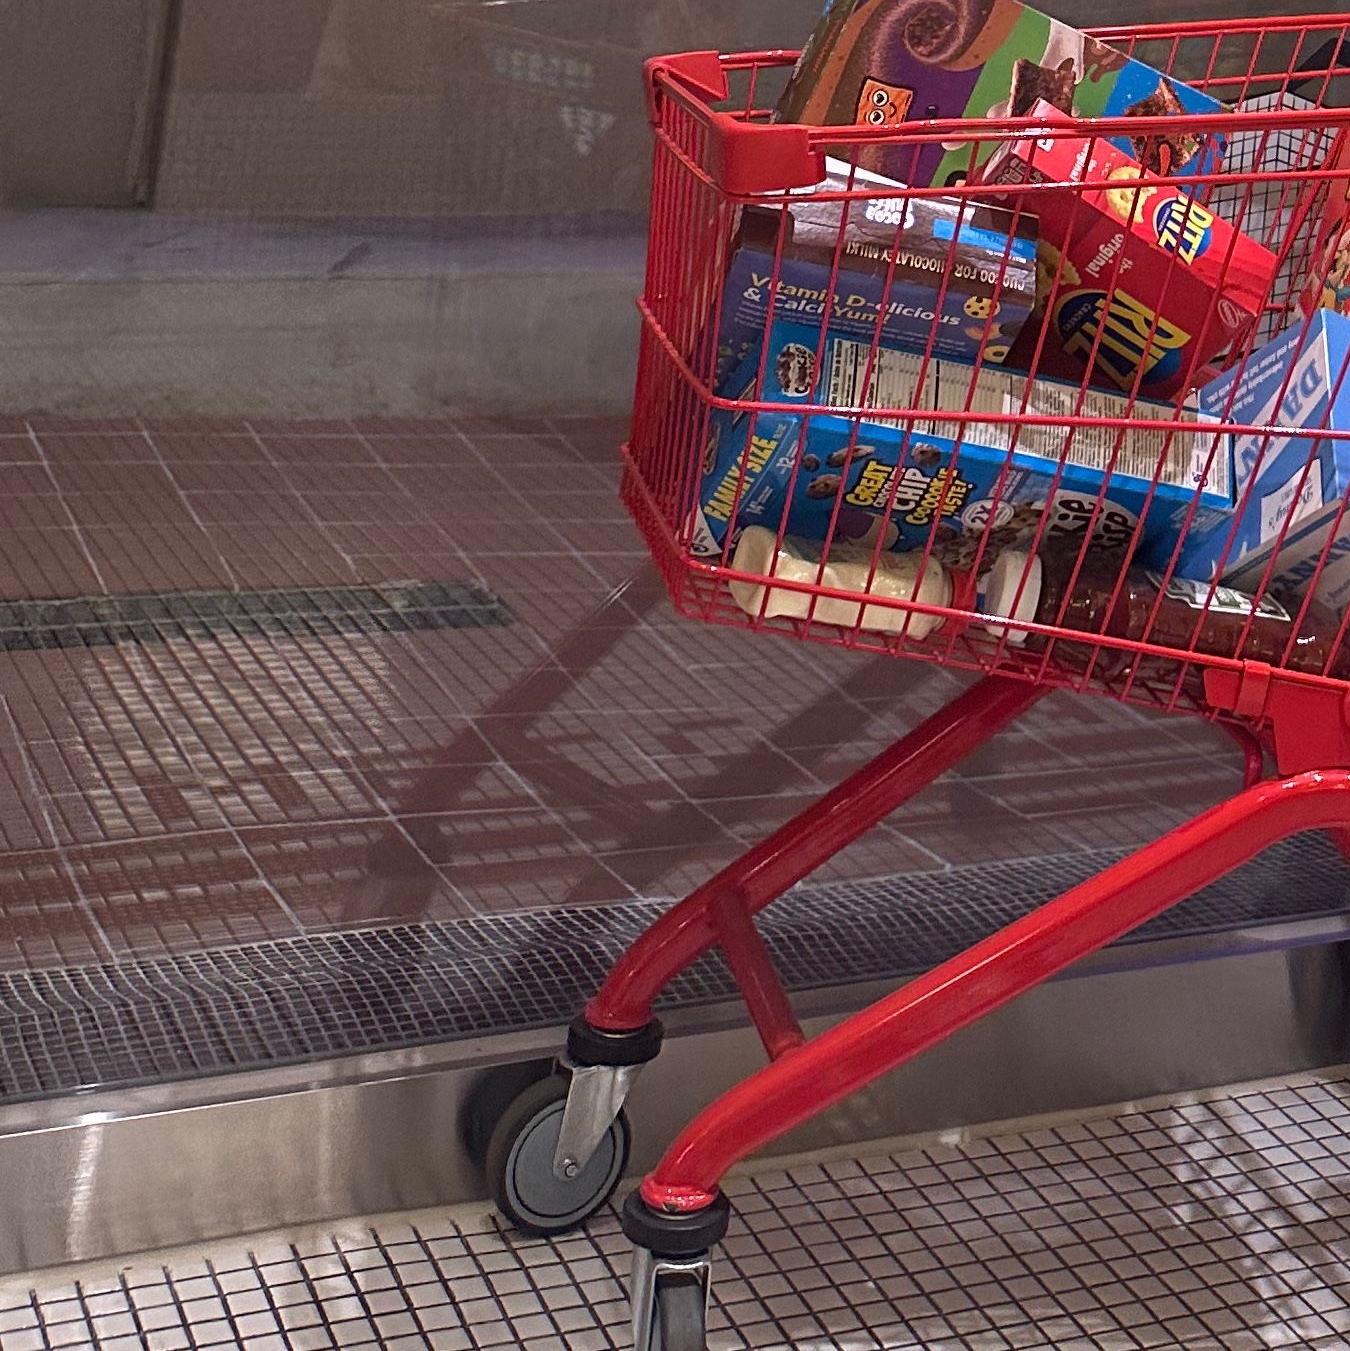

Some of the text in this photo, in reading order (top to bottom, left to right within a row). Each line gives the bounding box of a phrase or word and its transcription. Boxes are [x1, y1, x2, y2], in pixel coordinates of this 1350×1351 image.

[881, 248, 948, 275] HOCOLATEY
[977, 268, 1026, 291] CUCOO
[1062, 288, 1192, 393] RITZ
[845, 460, 886, 508] GREAT
[892, 467, 931, 512] CHIP
